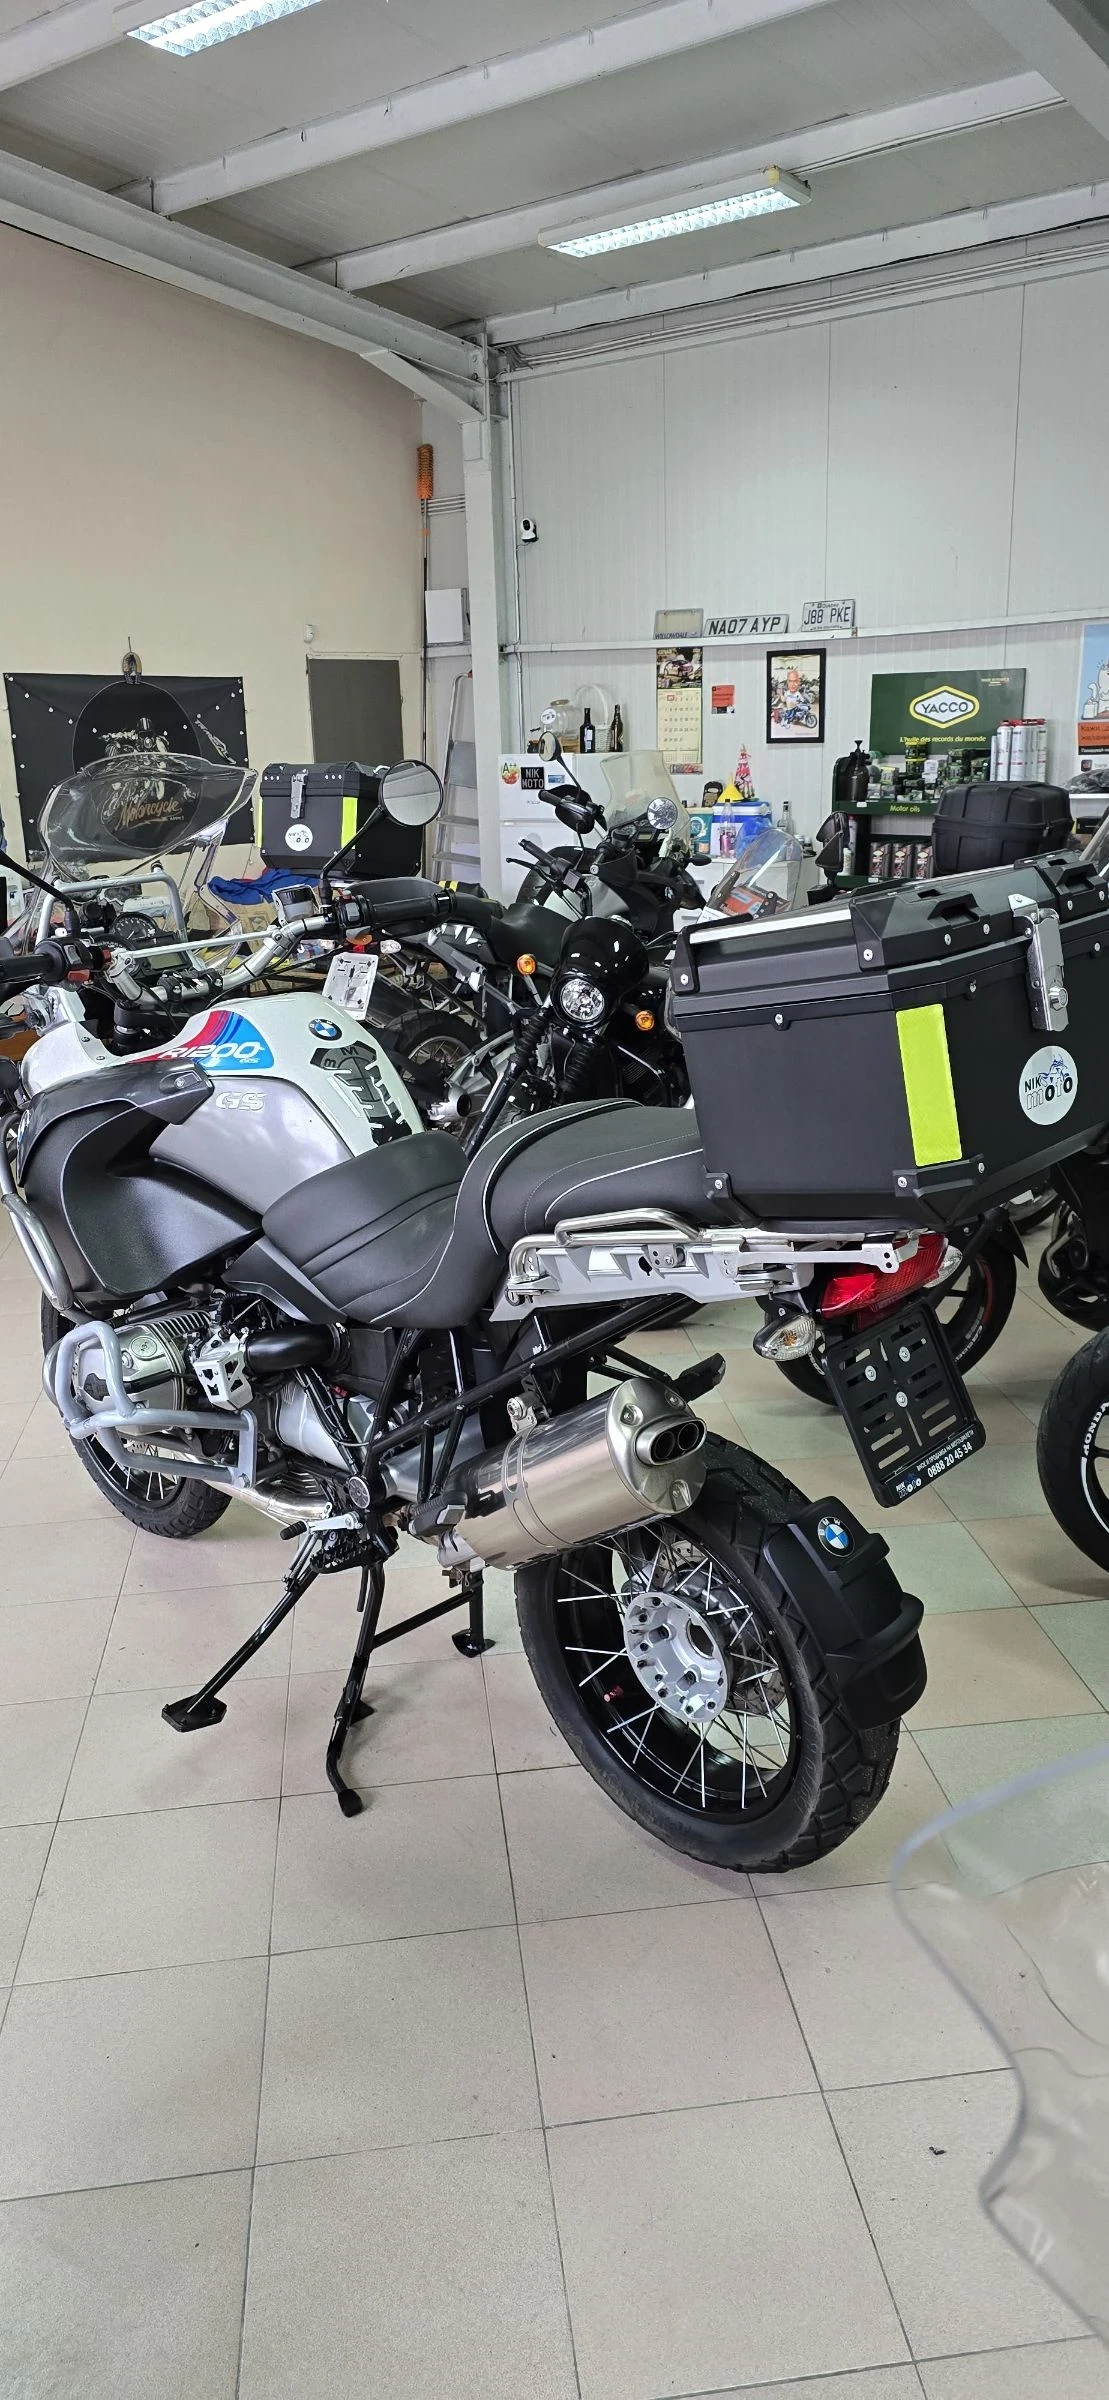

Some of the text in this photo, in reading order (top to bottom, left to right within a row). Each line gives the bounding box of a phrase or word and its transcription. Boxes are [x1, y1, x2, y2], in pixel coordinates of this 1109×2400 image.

[804, 606, 851, 625] J88 PKE
[708, 616, 781, 636] NA07 AYP
[921, 701, 969, 714] YACCO
[932, 735, 954, 743] records
[955, 734, 964, 742] du
[503, 762, 516, 774] A++
[525, 768, 539, 778] NIK
[522, 779, 544, 789] MOTO
[114, 798, 183, 831] Motorcycle
[1024, 1074, 1042, 1093] NIK
[1027, 1076, 1073, 1110] moto
[215, 1092, 267, 1112] GS
[927, 1441, 973, 1478] 0888 20 45 34
